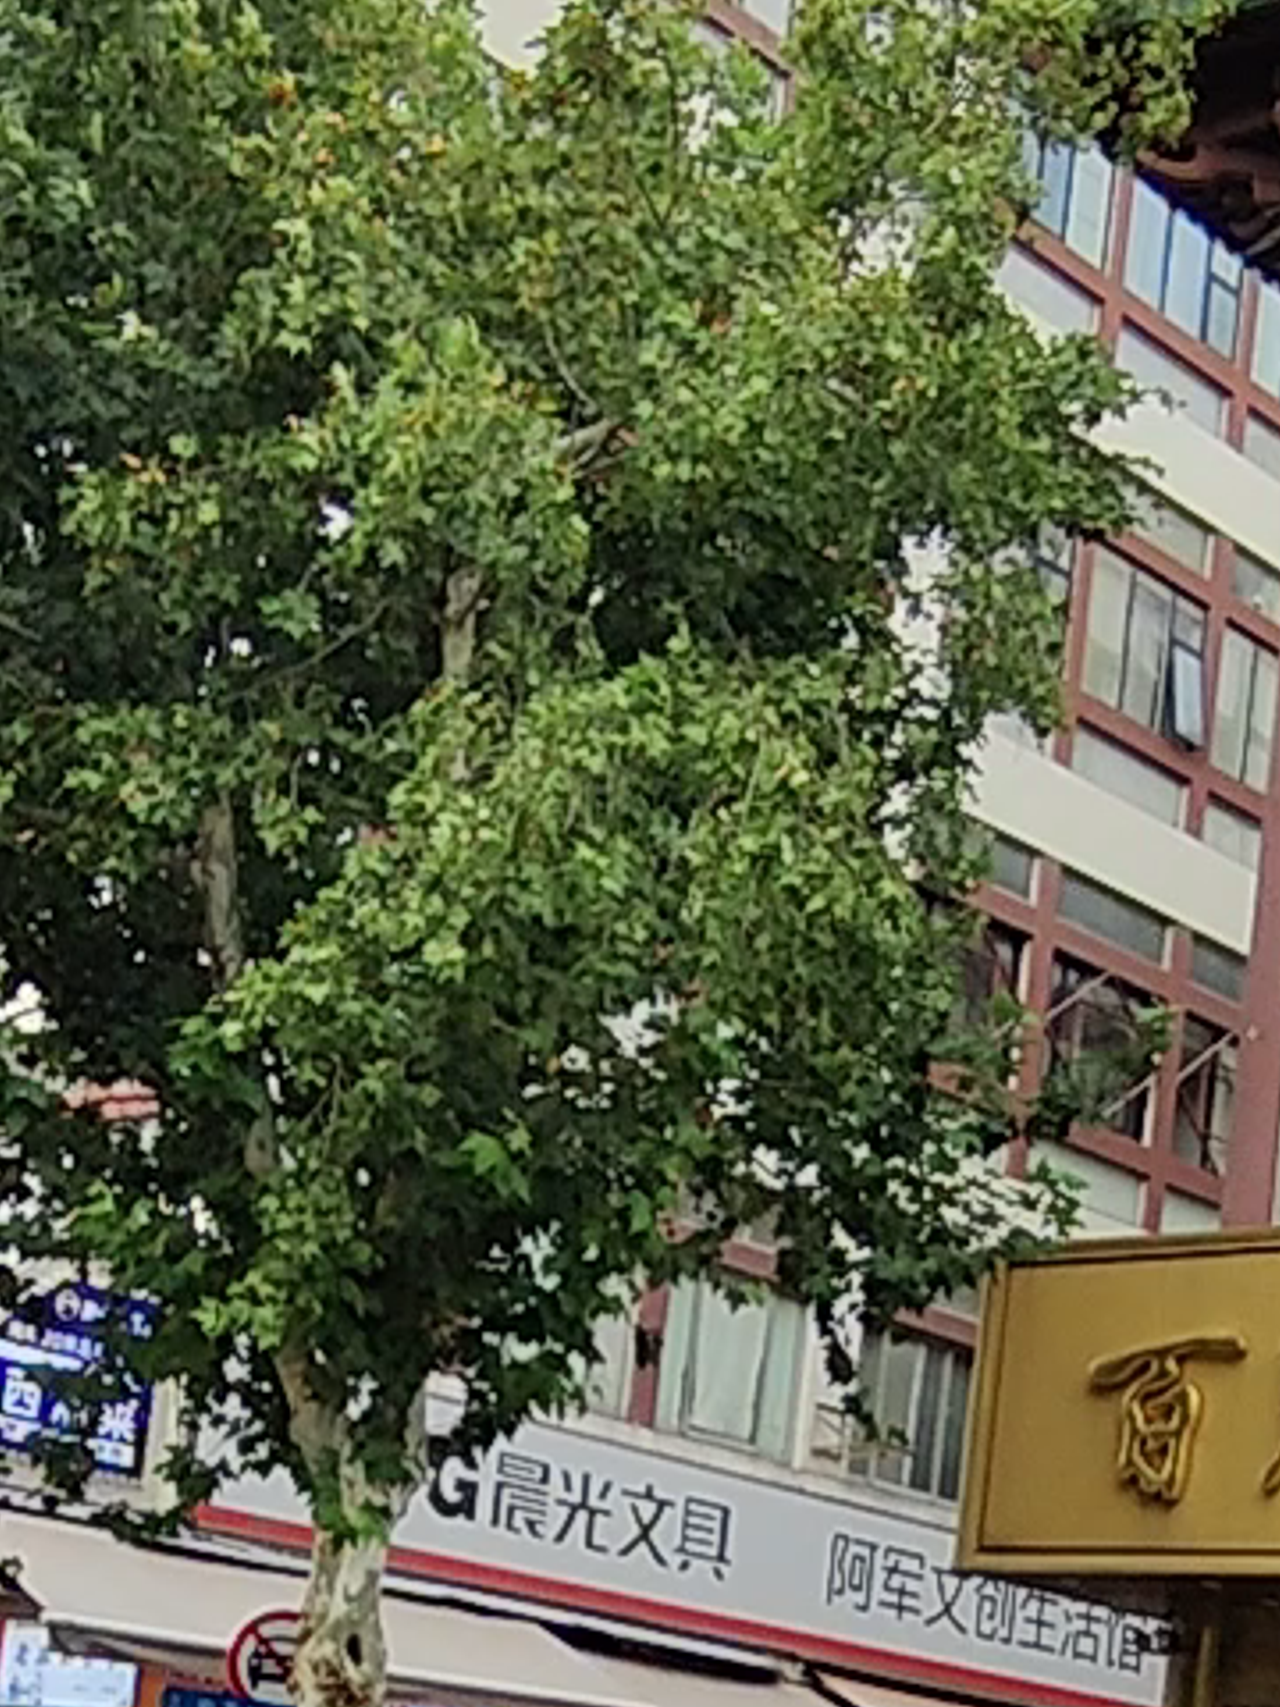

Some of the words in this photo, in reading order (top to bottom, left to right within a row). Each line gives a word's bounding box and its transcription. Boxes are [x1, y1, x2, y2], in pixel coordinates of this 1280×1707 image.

[490, 1450, 732, 1581] 晨光文具
[826, 1532, 1144, 1676] 阿军文创生活馆
